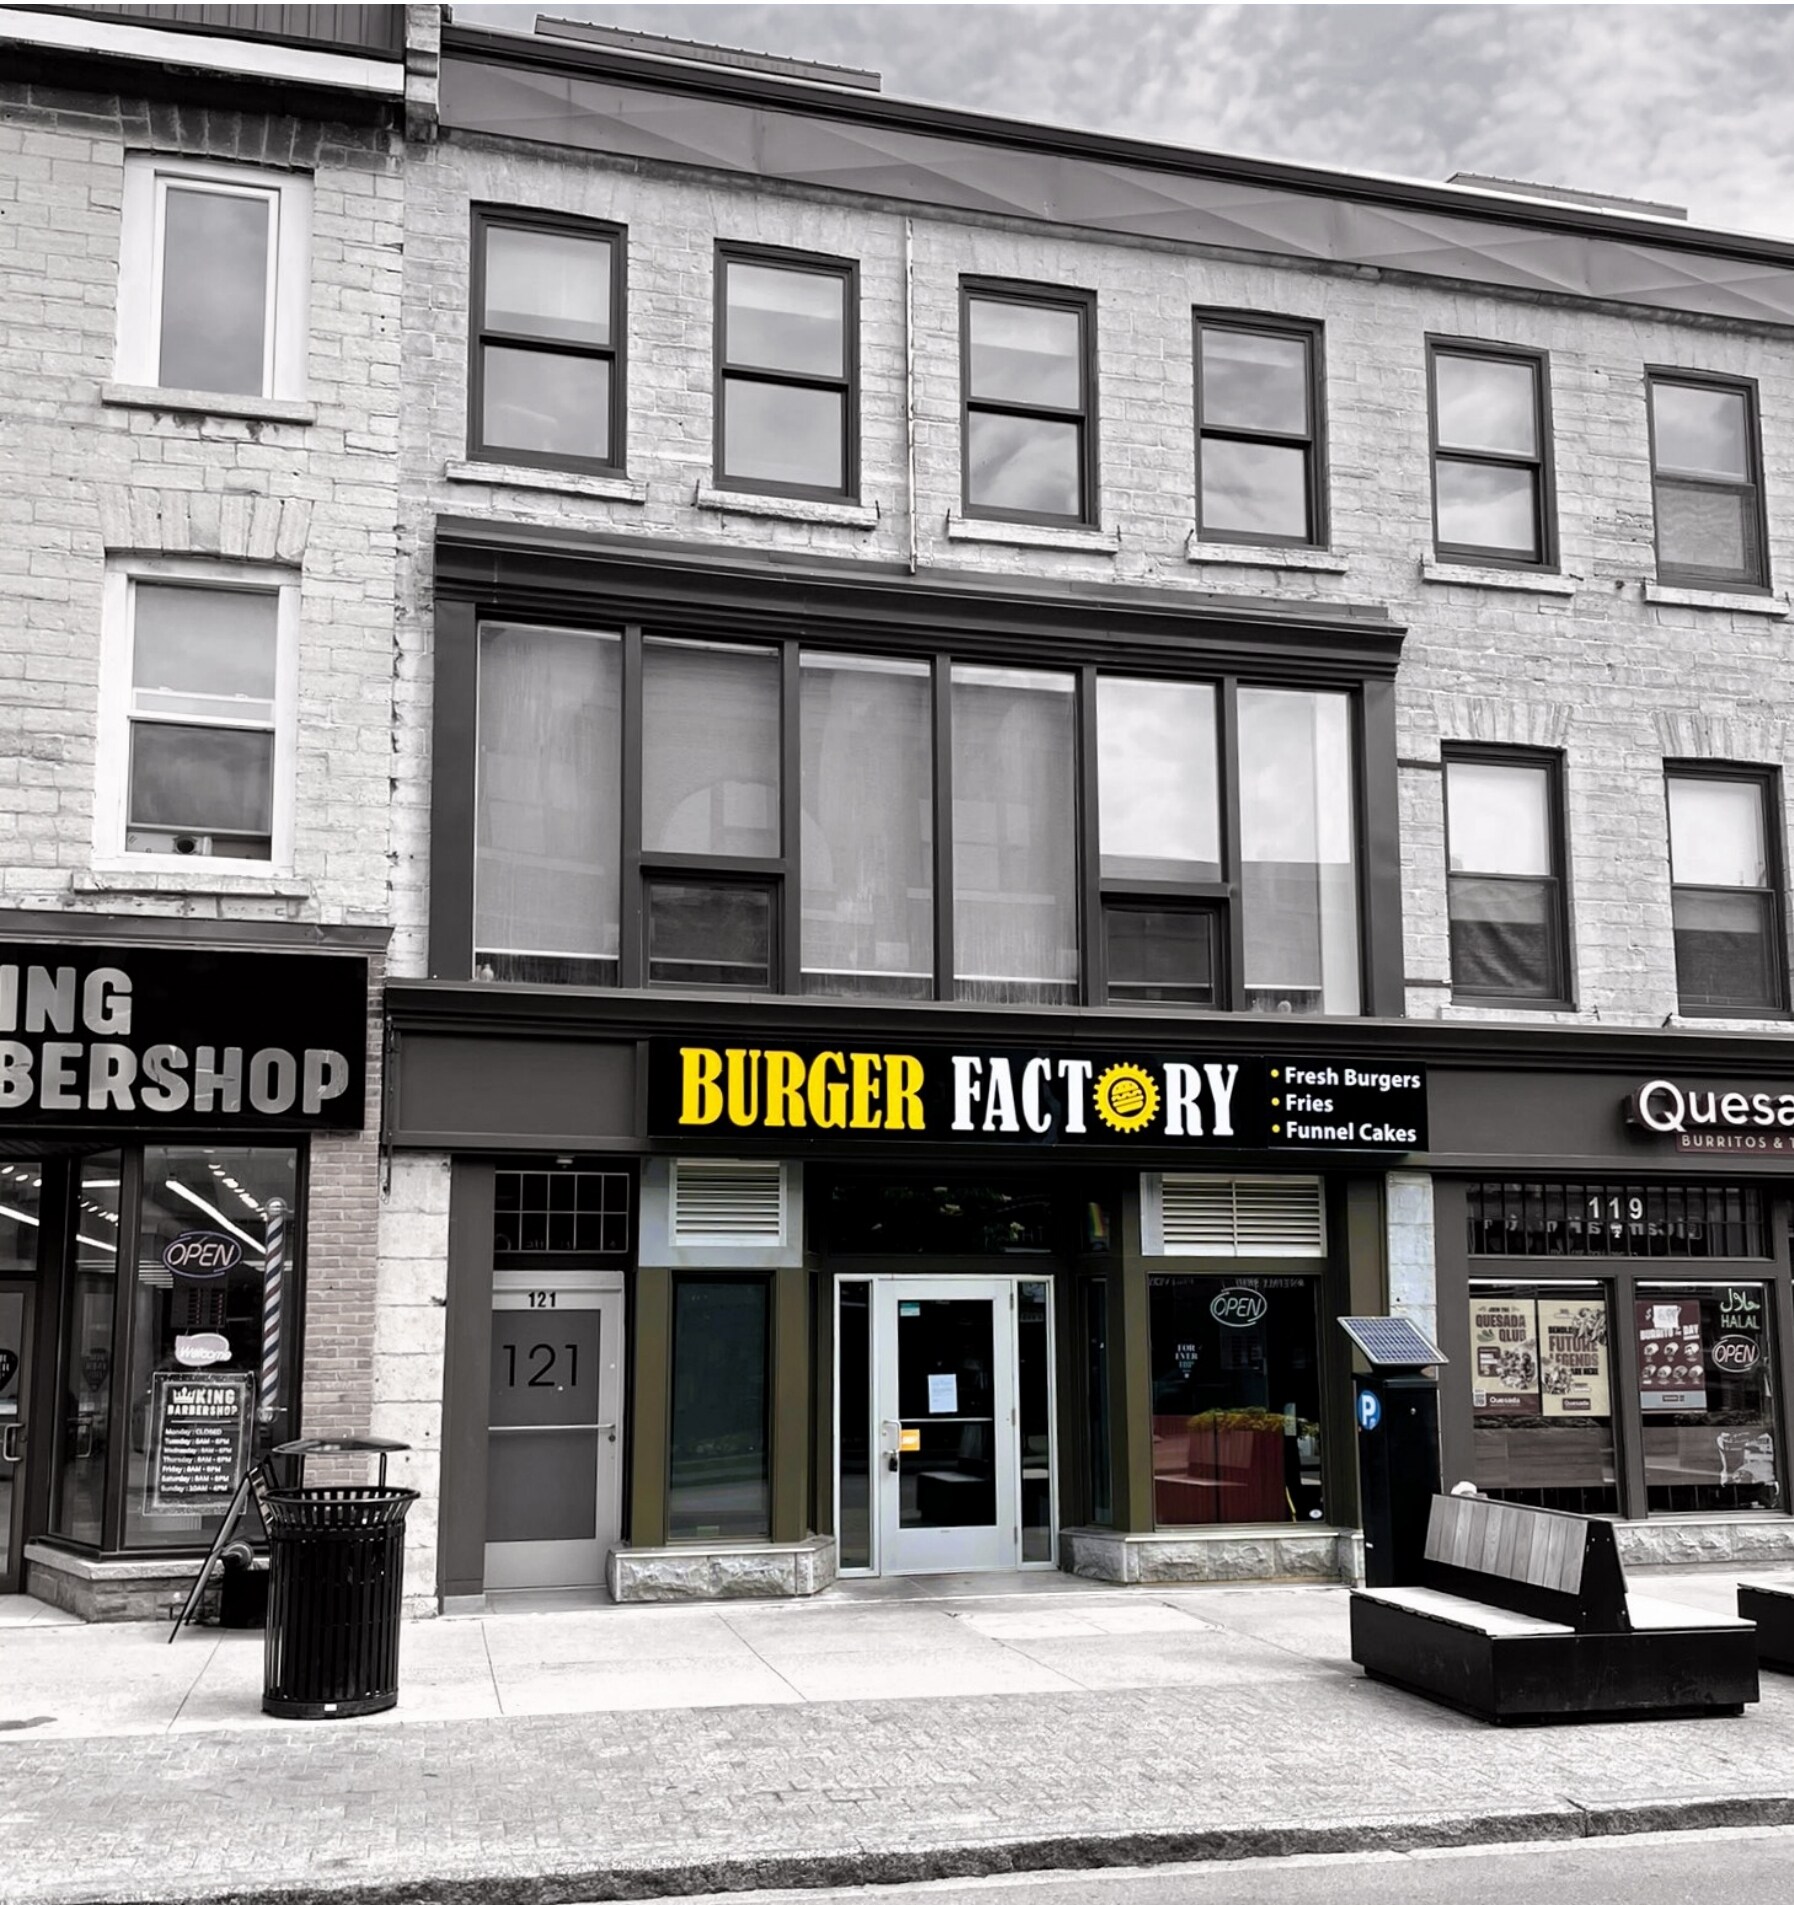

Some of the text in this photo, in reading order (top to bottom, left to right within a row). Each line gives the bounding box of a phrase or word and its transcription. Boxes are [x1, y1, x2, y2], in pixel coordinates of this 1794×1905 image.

[0, 964, 133, 1035] ING
[0, 1040, 349, 1114] BERSHOP
[1285, 1066, 1421, 1092] Fresh Burgers
[679, 1047, 1239, 1136] BURGER FACTORY
[1286, 1093, 1334, 1112] Fries
[1639, 1079, 1794, 1132] Quesa
[1286, 1121, 1417, 1142] Funnel Cakes
[1681, 1134, 1767, 1149] BURRITOS
[1773, 1136, 1783, 1149] &
[1588, 1197, 1643, 1220] 119
[167, 1243, 235, 1266] OPEN
[528, 1291, 556, 1308] 121
[1213, 1297, 1262, 1317] OPEN
[1720, 1288, 1760, 1312] حلال
[1476, 1314, 1526, 1328] QUESADA
[1721, 1314, 1760, 1329] HALAL
[1714, 1344, 1755, 1363] OPEN
[503, 1344, 577, 1387] 121
[195, 1388, 236, 1404] KING
[167, 1405, 238, 1416] BARBERSHOP
[1361, 1394, 1376, 1427] P
